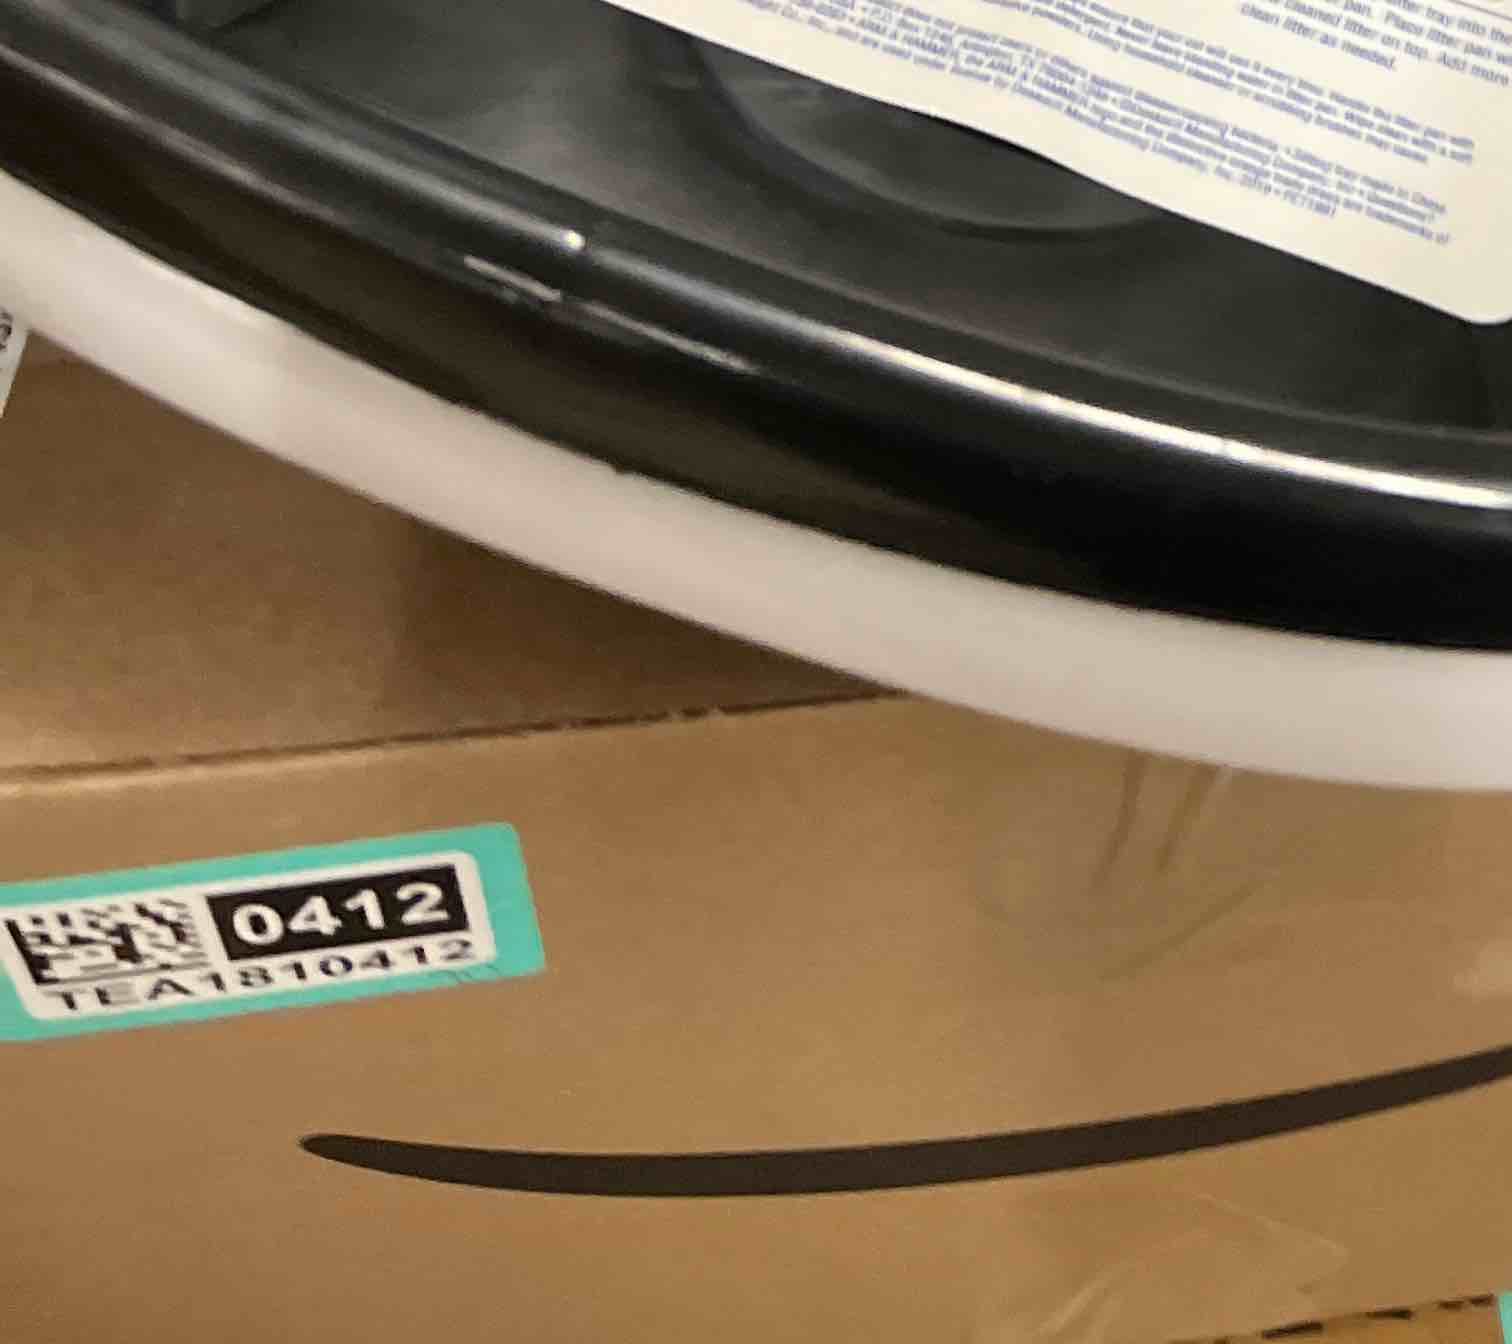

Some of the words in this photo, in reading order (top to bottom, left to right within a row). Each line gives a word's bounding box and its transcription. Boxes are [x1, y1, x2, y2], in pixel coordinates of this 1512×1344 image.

[1237, 1, 1282, 29] clean
[1280, 16, 1318, 42] litter
[1376, 7, 1425, 37] Place
[1424, 25, 1462, 51] litter
[1461, 38, 1494, 62] pan
[1423, 4, 1456, 28] tray
[1341, 16, 1380, 42] litter
[1433, 48, 1469, 73] Add
[232, 881, 450, 947] 0412
[41, 937, 478, 1012] TEA1810412
